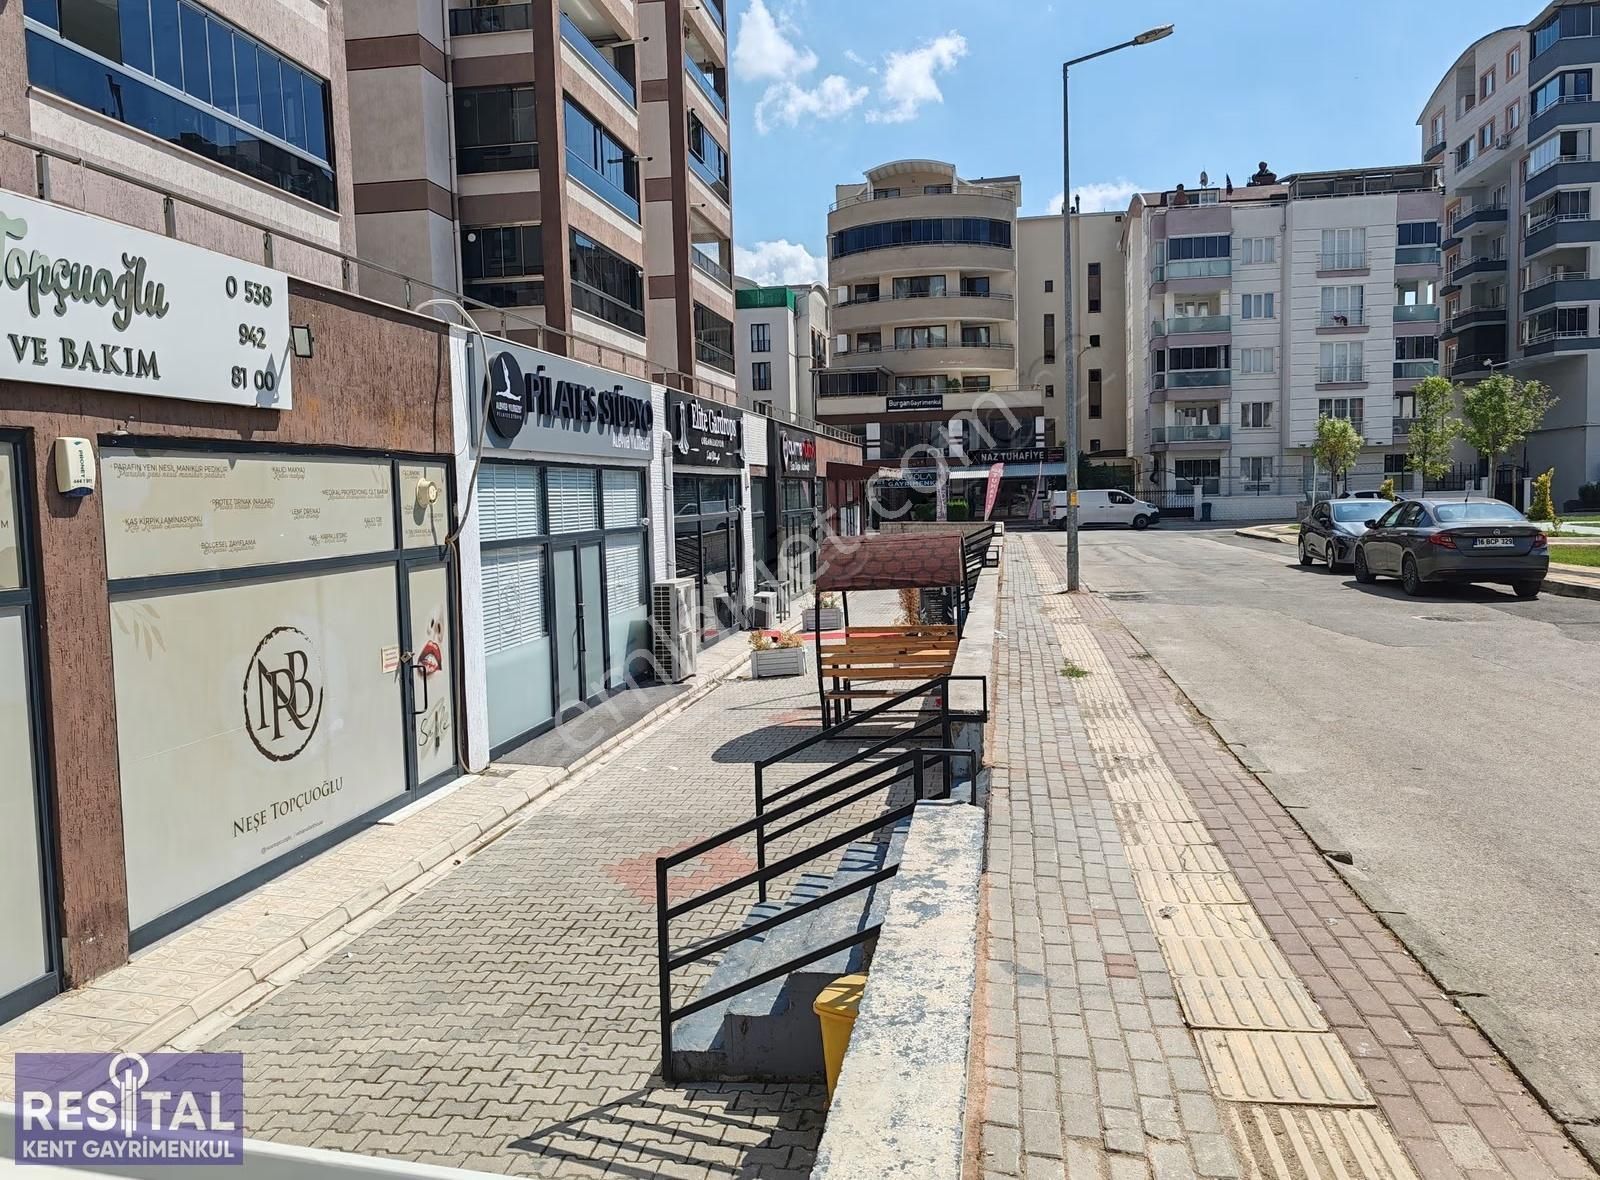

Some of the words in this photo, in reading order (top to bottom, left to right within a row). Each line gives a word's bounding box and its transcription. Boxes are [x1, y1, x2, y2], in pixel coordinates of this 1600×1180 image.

[226, 275, 238, 299] 0
[244, 280, 273, 308] 538
[238, 323, 267, 350] 942
[8, 333, 48, 367] VE
[59, 337, 162, 381] BAKIM
[231, 366, 248, 390] 81
[254, 369, 275, 391] 00
[691, 400, 709, 433] Elite
[709, 408, 737, 441] Gardrops
[981, 452, 999, 461] NAZ
[1000, 450, 1045, 460] TUHAFİYE
[233, 809, 267, 838] NEŞE
[270, 776, 343, 820] TOPÇUOĞLU
